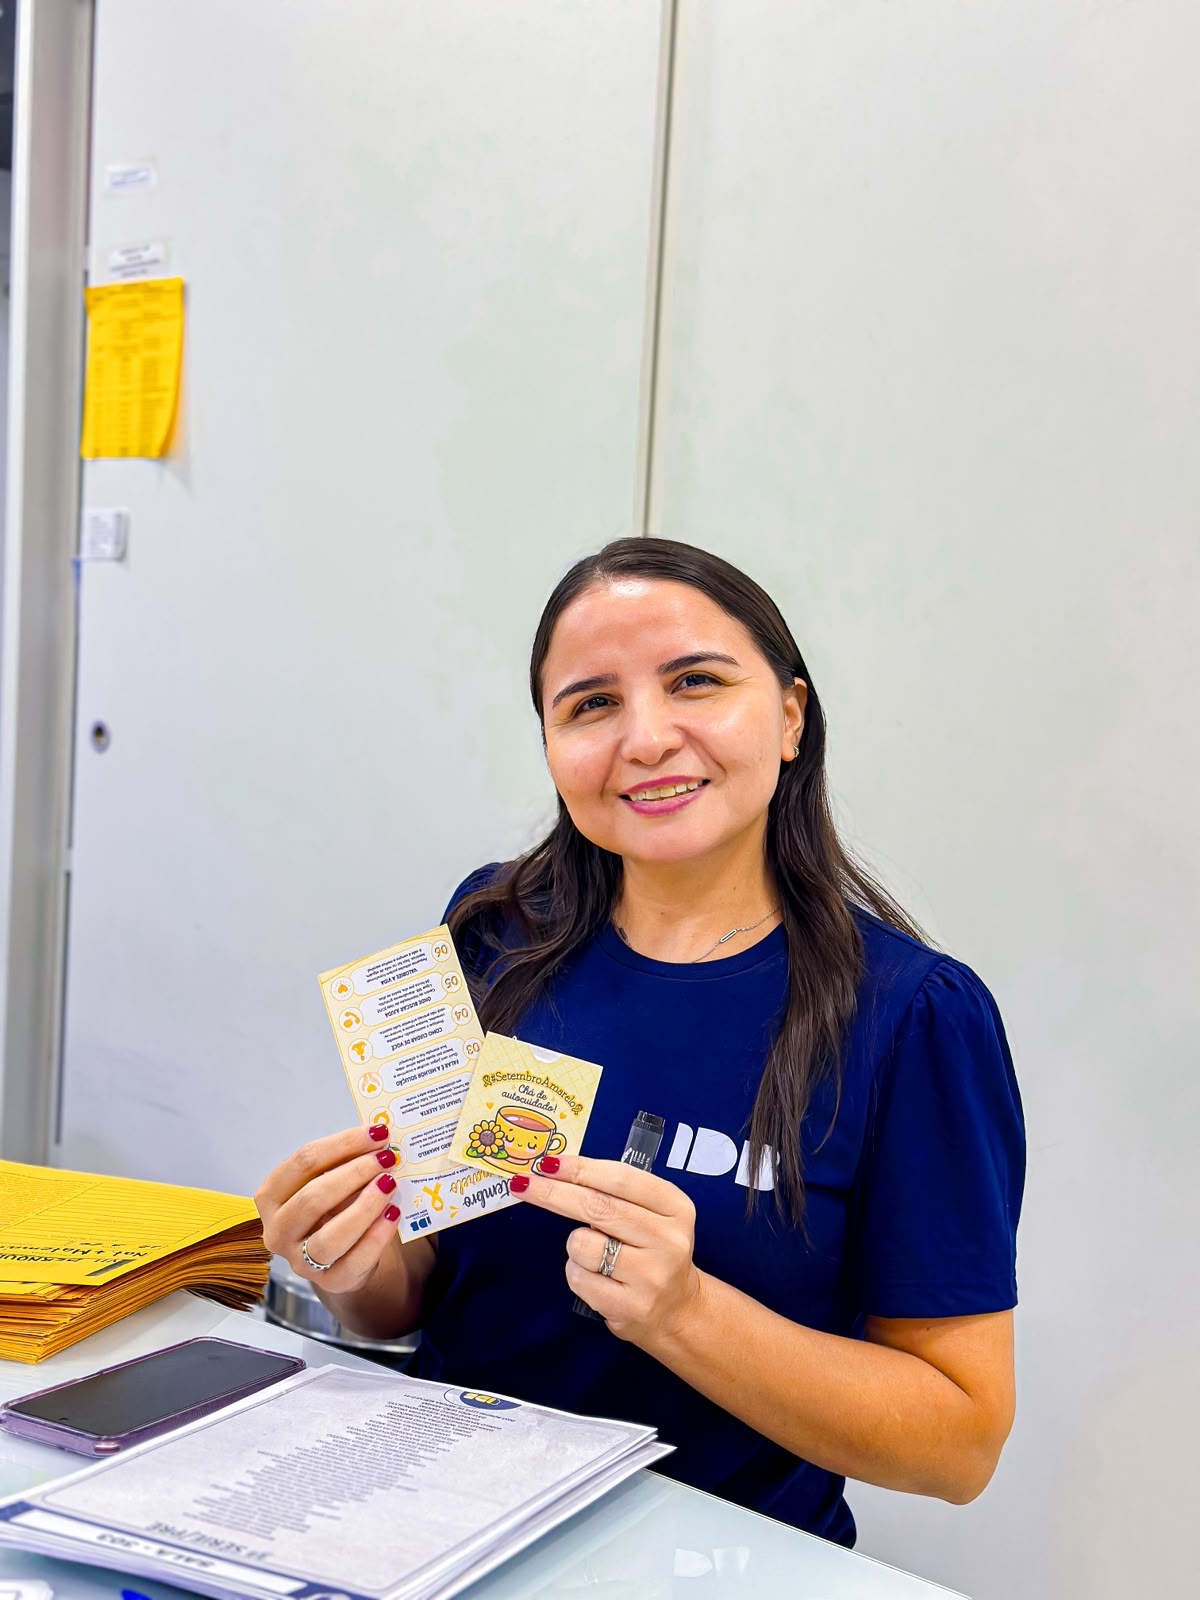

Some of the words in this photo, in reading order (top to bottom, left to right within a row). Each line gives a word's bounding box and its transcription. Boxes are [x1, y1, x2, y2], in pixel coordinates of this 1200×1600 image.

[434, 944, 447, 957] 06
[396, 967, 417, 979] VALORIZE
[444, 975, 458, 988] 05
[418, 996, 431, 1004] ONDE
[400, 1001, 418, 1011] BUSCAR
[384, 1008, 399, 1017] AJUDA
[454, 1007, 468, 1020] 04
[410, 1032, 427, 1042] CUIDAR
[427, 1027, 442, 1036] COMO
[390, 1041, 403, 1051] VOCÊ
[465, 1042, 480, 1054] 03
[444, 1059, 459, 1068] FALAR
[417, 1067, 436, 1078] MELHOR
[395, 1074, 417, 1086] SOLUÇÃO
[518, 1084, 536, 1096] Chá
[536, 1089, 548, 1100] de
[501, 1090, 558, 1113] autocuidado!
[419, 1106, 437, 1116] ALERTA
[417, 1146, 439, 1157] AMARELO
[462, 1175, 512, 1208] tembro
[410, 1216, 431, 1231] IDB
